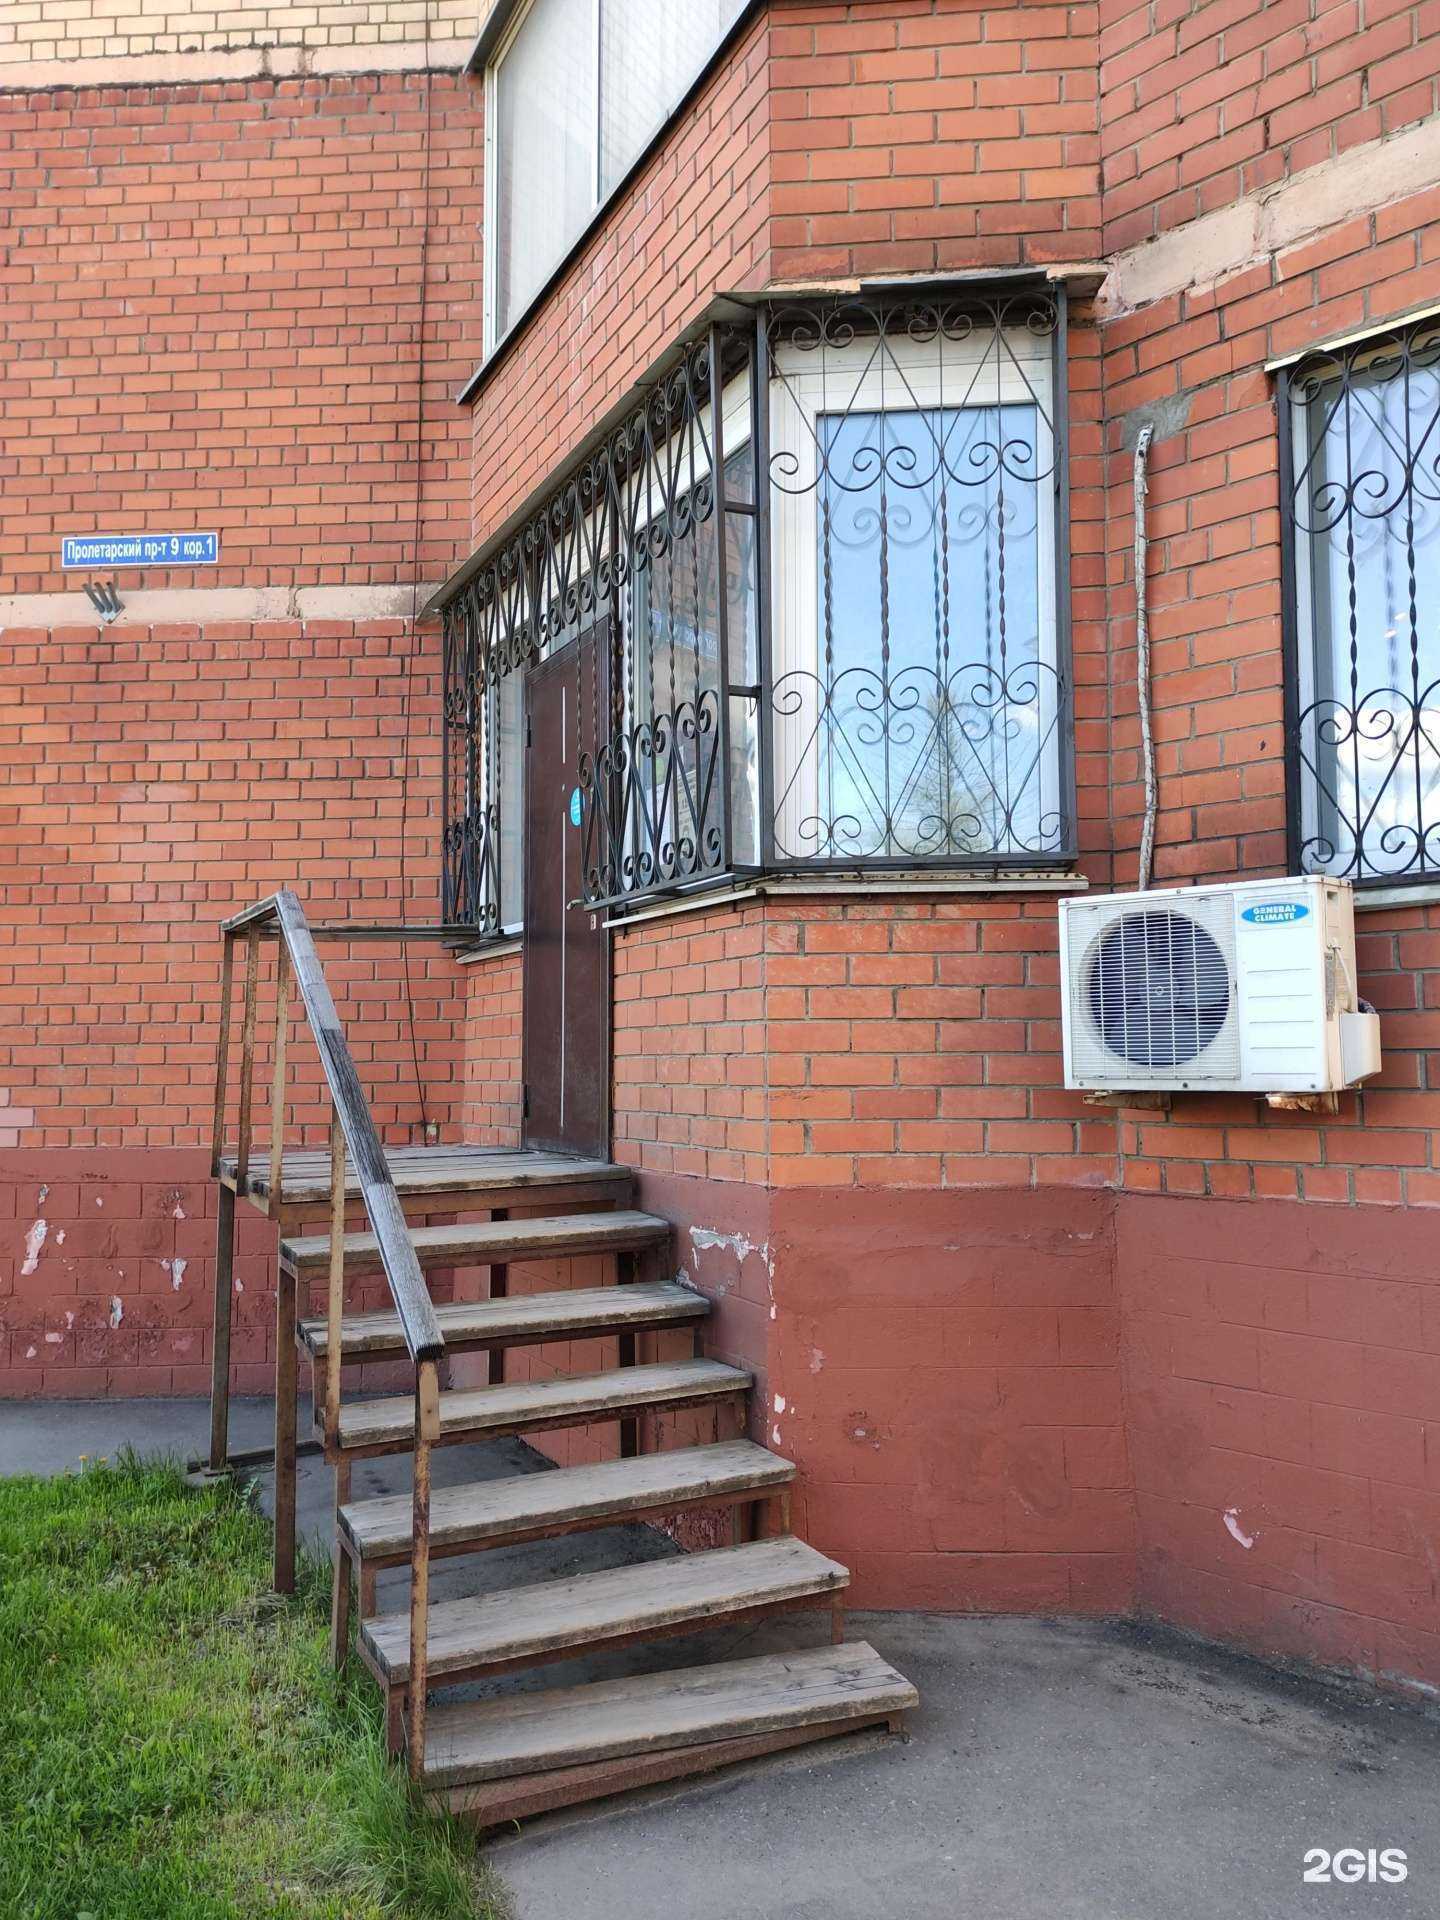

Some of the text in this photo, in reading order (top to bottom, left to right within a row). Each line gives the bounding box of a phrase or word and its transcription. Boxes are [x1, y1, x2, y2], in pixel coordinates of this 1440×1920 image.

[67, 540, 142, 562] Пролетарский
[145, 542, 166, 560] пр-т
[171, 537, 179, 556] 9
[1253, 905, 1296, 915] GENERAL
[1254, 912, 1295, 922] CLIMATE
